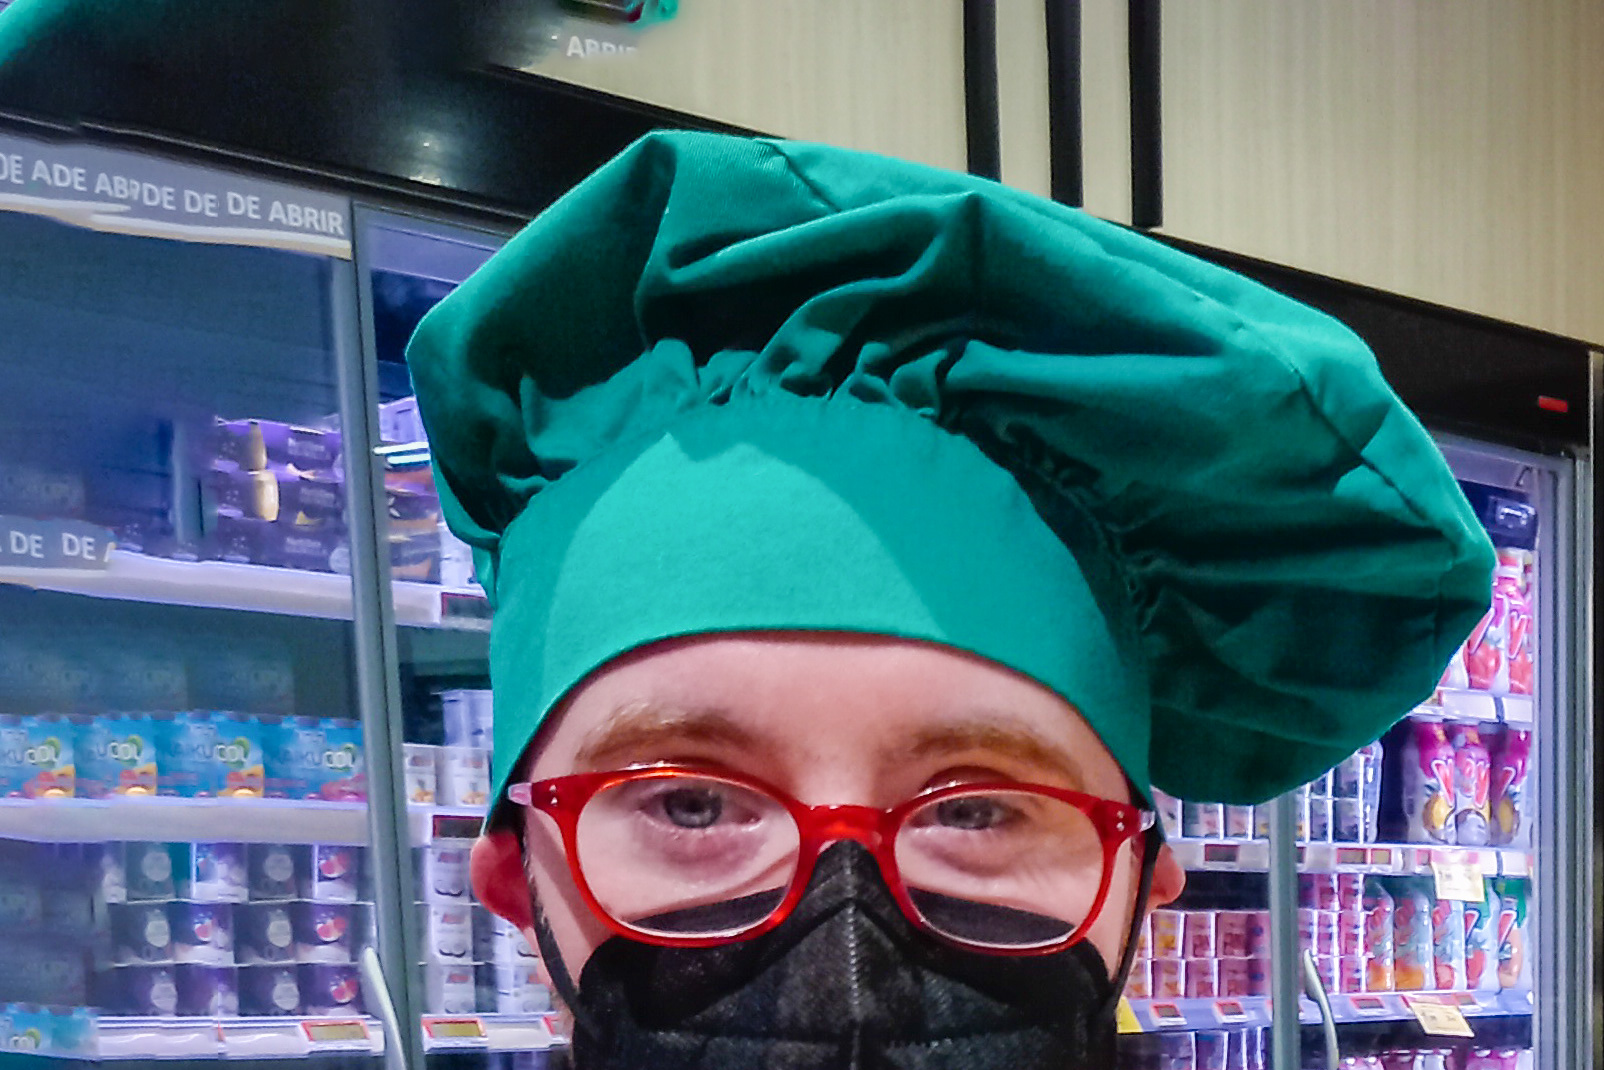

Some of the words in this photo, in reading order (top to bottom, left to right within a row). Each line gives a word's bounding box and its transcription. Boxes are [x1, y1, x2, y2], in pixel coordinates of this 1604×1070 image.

[184, 190, 218, 217] DE
[227, 191, 261, 219] DE
[268, 200, 344, 236] ABRIR
[10, 530, 45, 559] DE
[62, 532, 96, 561] DE
